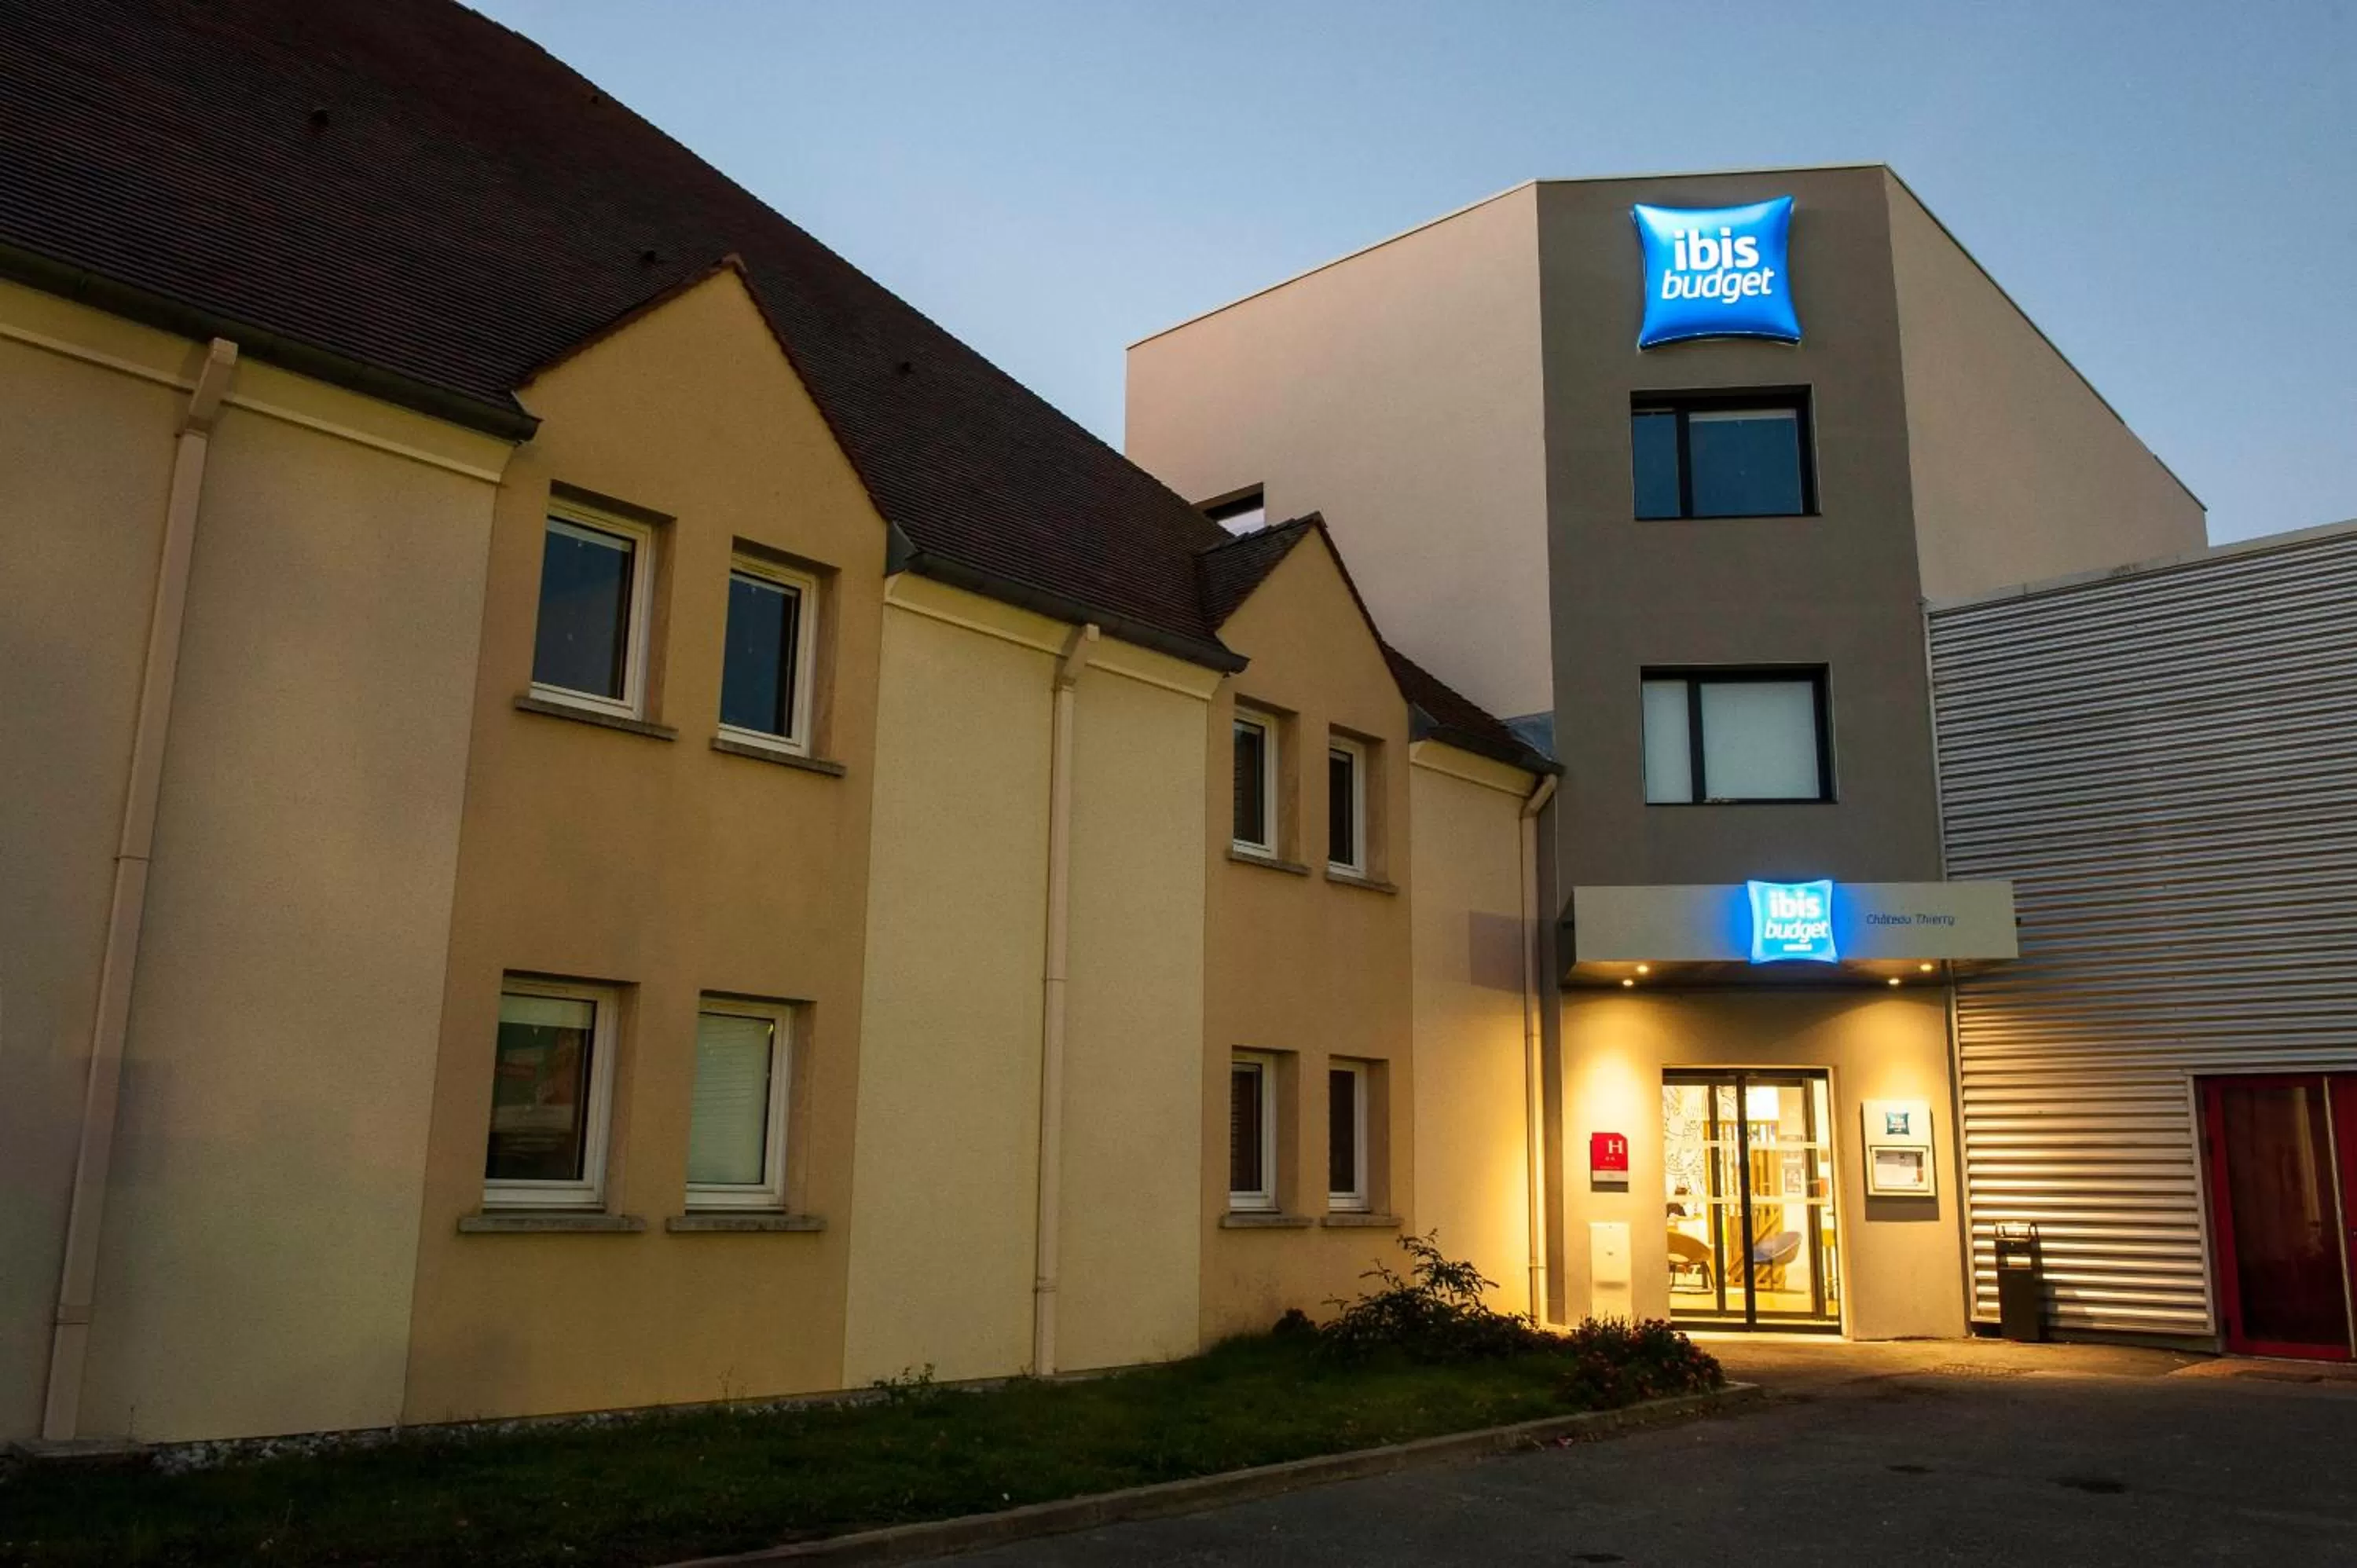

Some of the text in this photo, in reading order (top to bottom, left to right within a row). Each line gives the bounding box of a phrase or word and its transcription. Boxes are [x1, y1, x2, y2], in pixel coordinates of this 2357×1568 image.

[1673, 226, 1759, 271] ibis
[1662, 267, 1774, 304] budget
[1769, 888, 1820, 918] ibis
[1765, 919, 1828, 943] budget
[1915, 914, 1956, 926] Thierry
[1608, 1140, 1622, 1154] H
